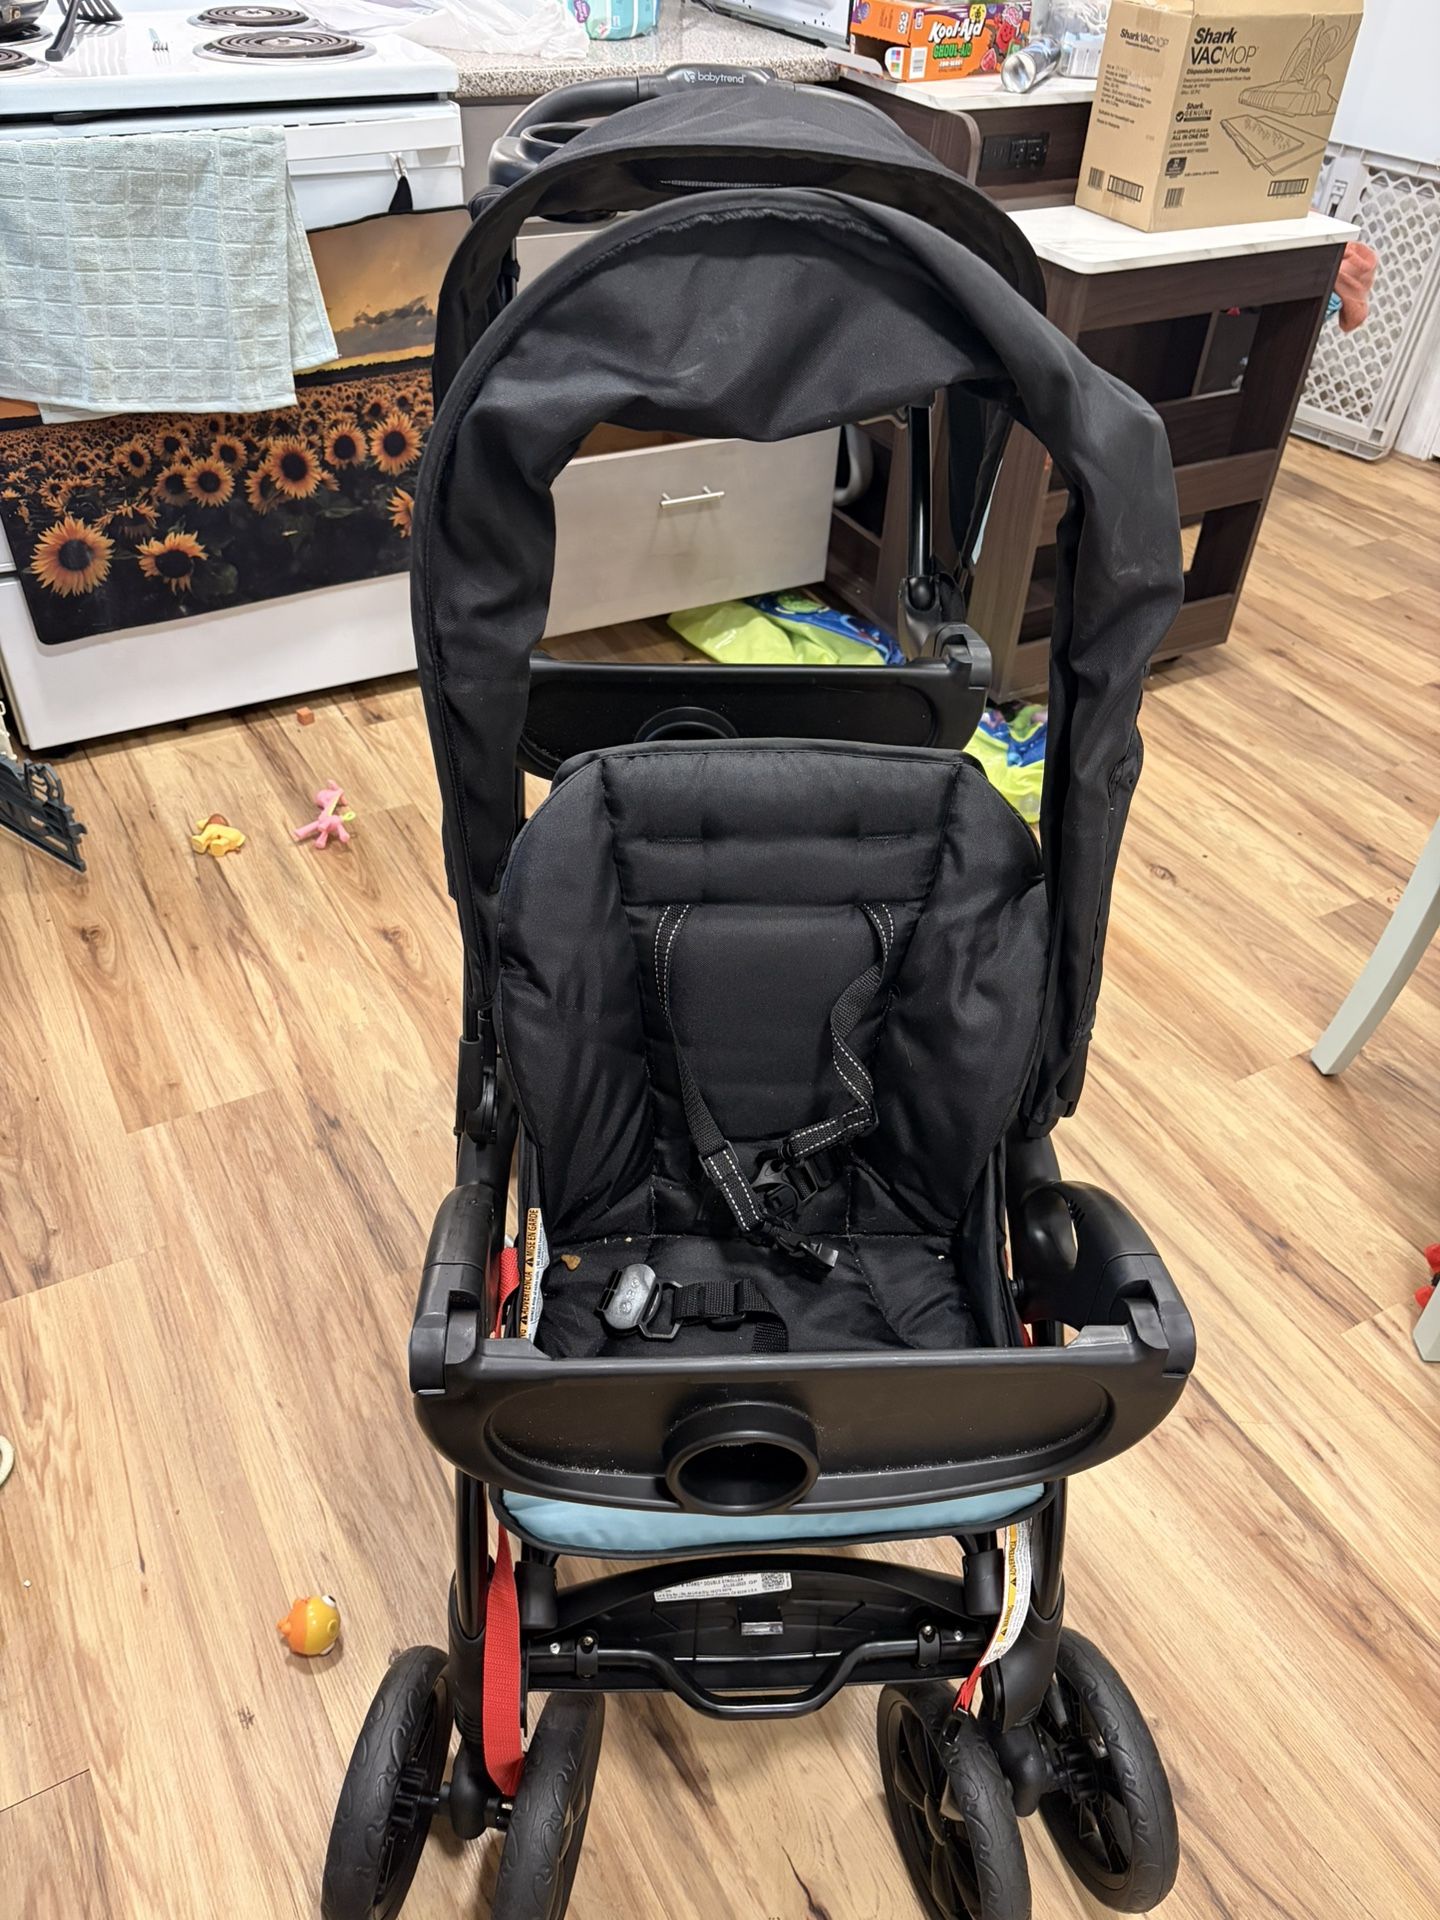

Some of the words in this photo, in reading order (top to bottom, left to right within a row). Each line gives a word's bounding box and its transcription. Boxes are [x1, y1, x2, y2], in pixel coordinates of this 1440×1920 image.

[928, 18, 986, 44] Kool-Aid
[1120, 28, 1140, 41] Shark
[1194, 27, 1238, 45] Shark
[1191, 46, 1257, 65] VACMOP
[697, 71, 745, 85] babytrend
[527, 1208, 539, 1232] GARDE
[527, 1231, 537, 1241] EN
[526, 1240, 536, 1257] MISE
[521, 1271, 533, 1315] ADVERTENCIA
